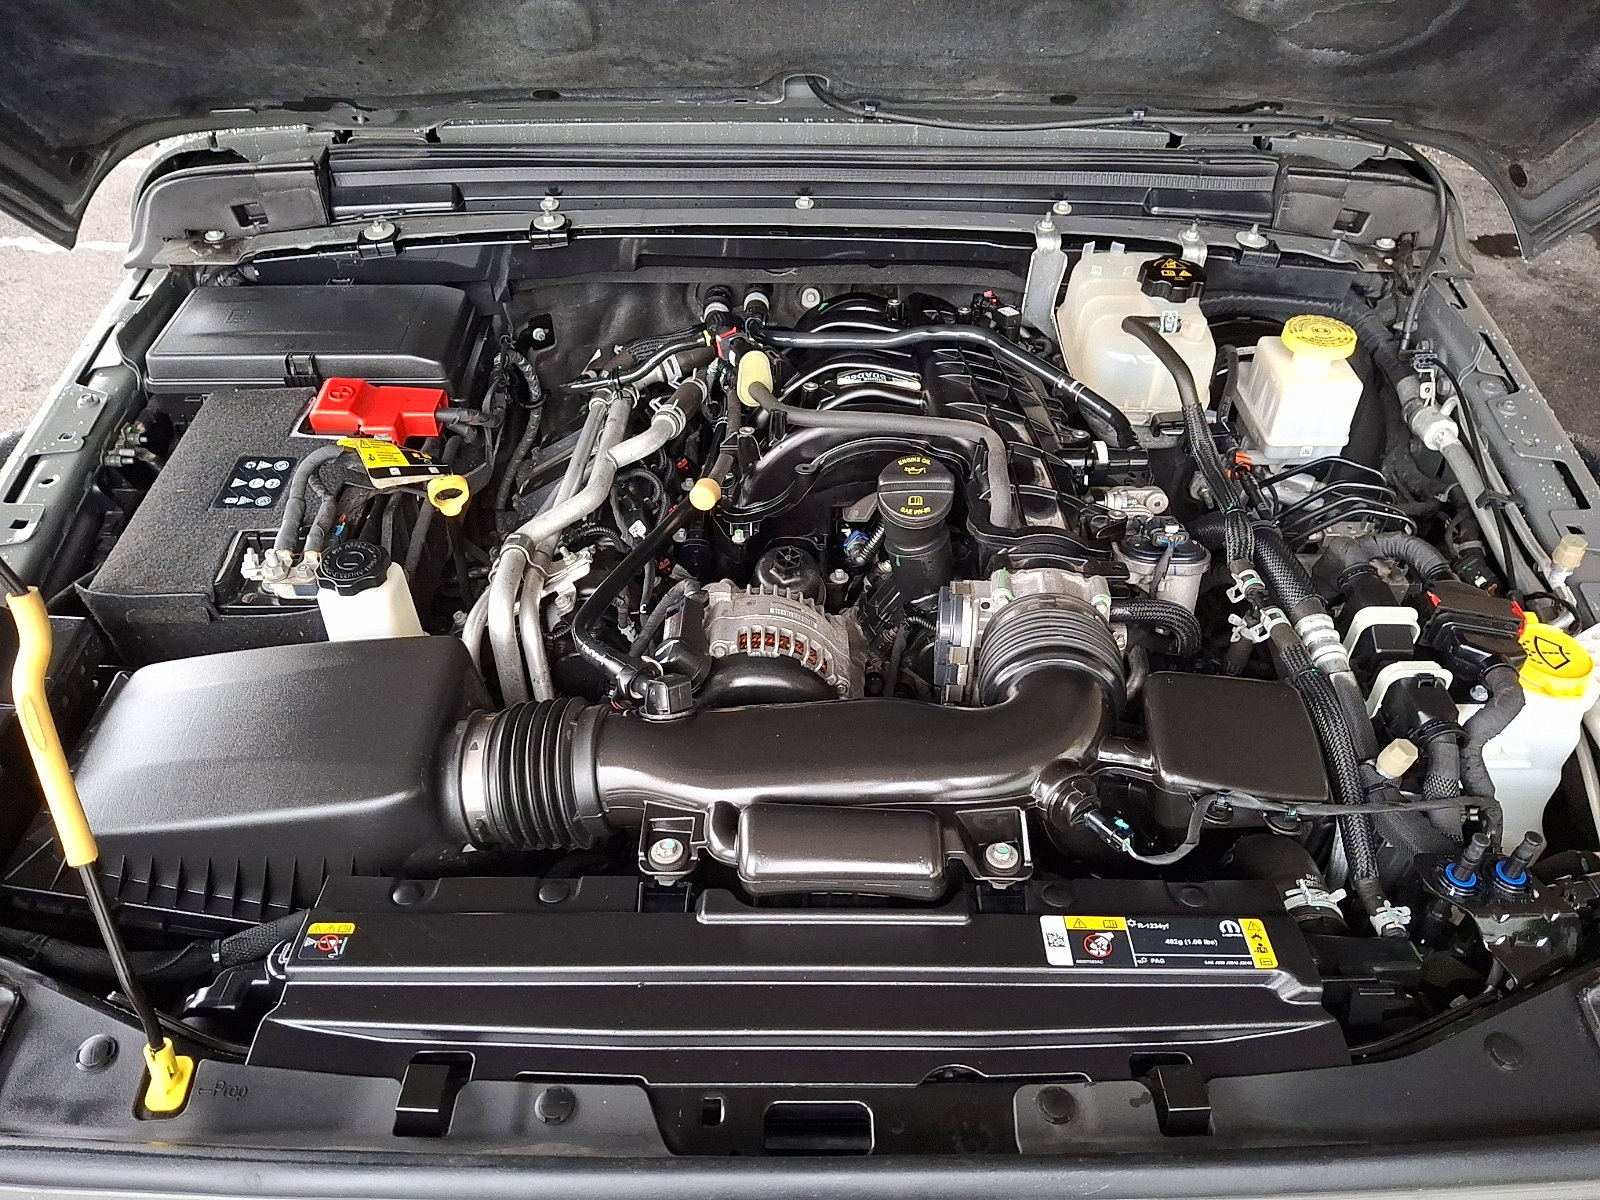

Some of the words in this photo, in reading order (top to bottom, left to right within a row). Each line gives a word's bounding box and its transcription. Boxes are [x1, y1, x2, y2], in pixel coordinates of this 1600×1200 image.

[897, 456, 921, 466] ENGINE
[921, 457, 931, 466] OIL
[213, 1080, 249, 1101] Prop
